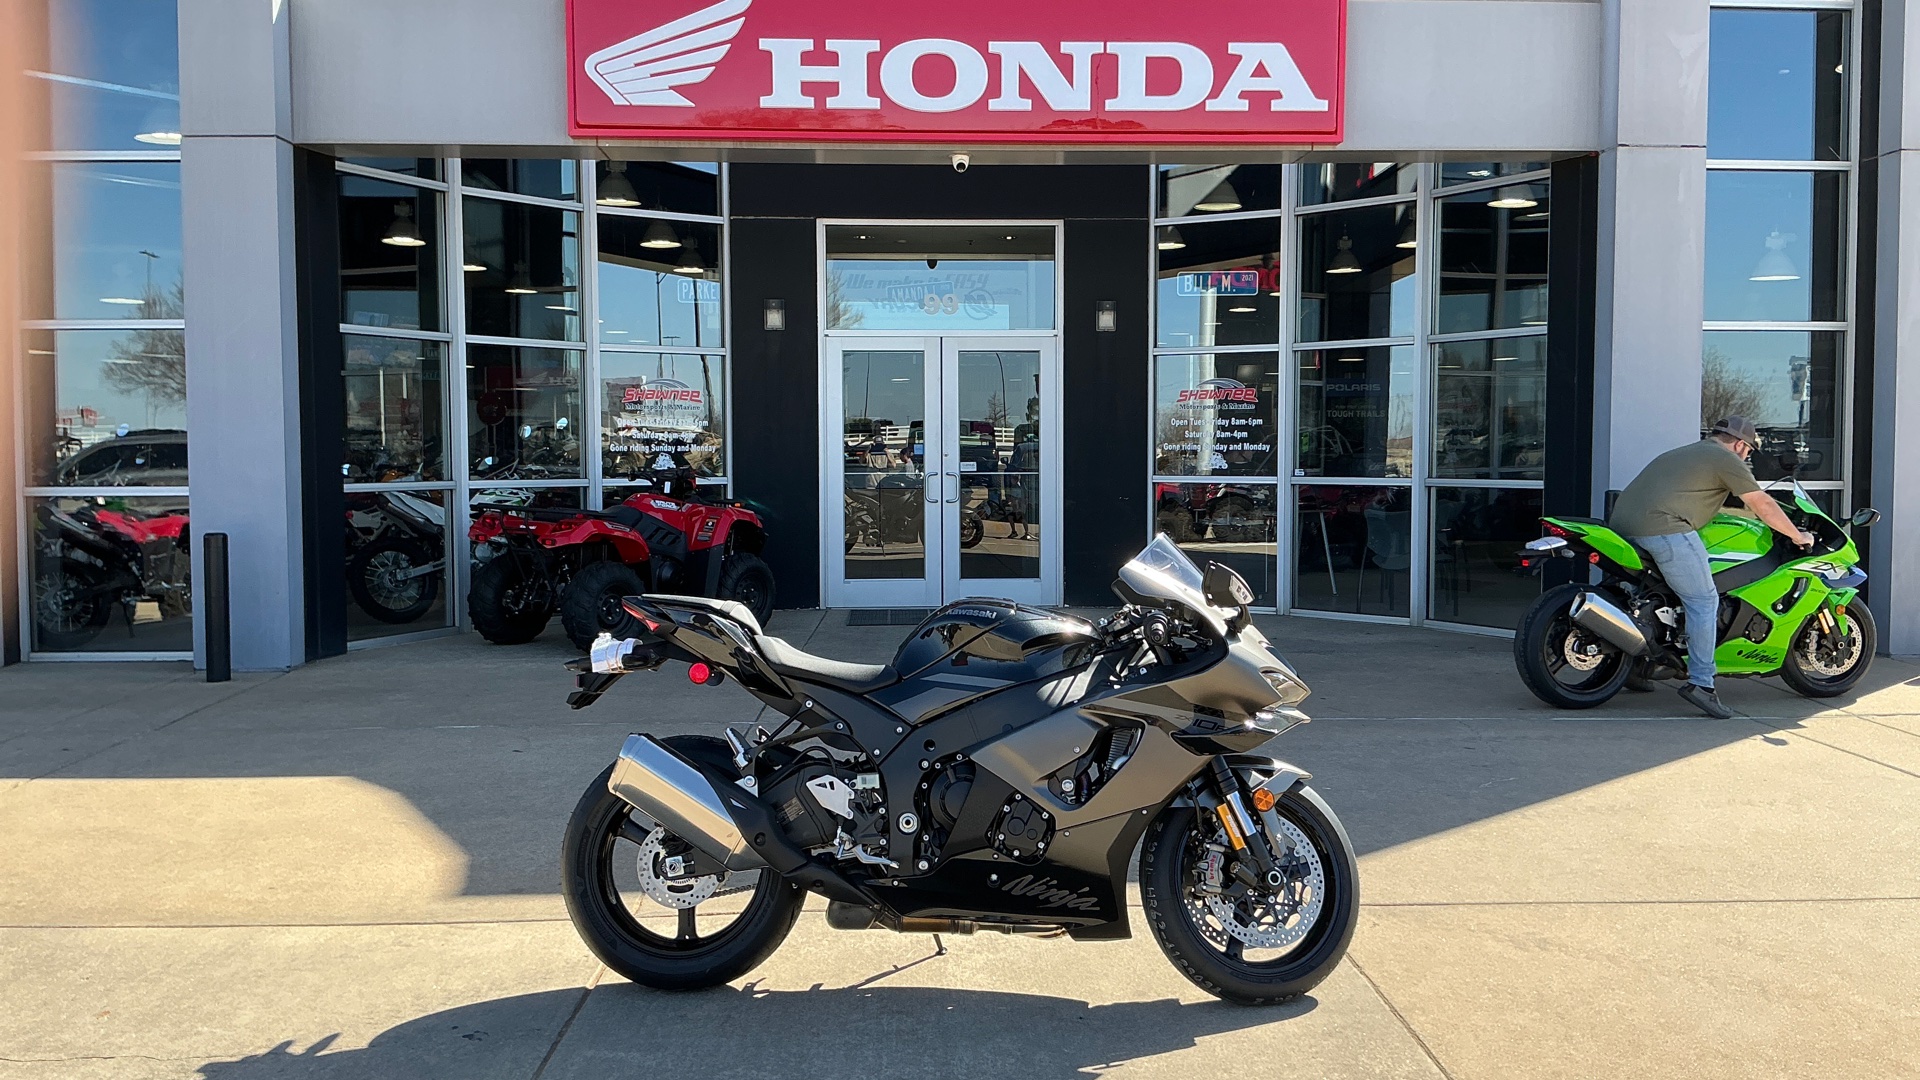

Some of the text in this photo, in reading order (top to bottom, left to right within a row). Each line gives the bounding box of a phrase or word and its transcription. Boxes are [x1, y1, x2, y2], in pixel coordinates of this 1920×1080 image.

[758, 38, 1329, 113] HONDA
[1222, 274, 1236, 292] M.
[1242, 274, 1254, 282] 2021
[682, 282, 717, 300] PARKE
[923, 293, 960, 316] 99
[1326, 383, 1381, 392] POLARIS
[1327, 410, 1386, 418] TOUGH TRAILS
[1171, 418, 1188, 428] Open
[1231, 417, 1263, 427] 8am-6pm
[1216, 430, 1248, 440] 8am-4pm
[610, 443, 716, 454] Gone riding Sunday and Monday
[1163, 443, 1181, 452] Gone
[1182, 442, 1201, 452] riding
[1229, 443, 1242, 451] and
[1244, 442, 1271, 453] Monday
[945, 608, 998, 620] Kawasaki
[1741, 648, 1779, 664] Ninja
[1209, 854, 1217, 880] brembo
[1001, 874, 1101, 911] Ninja
